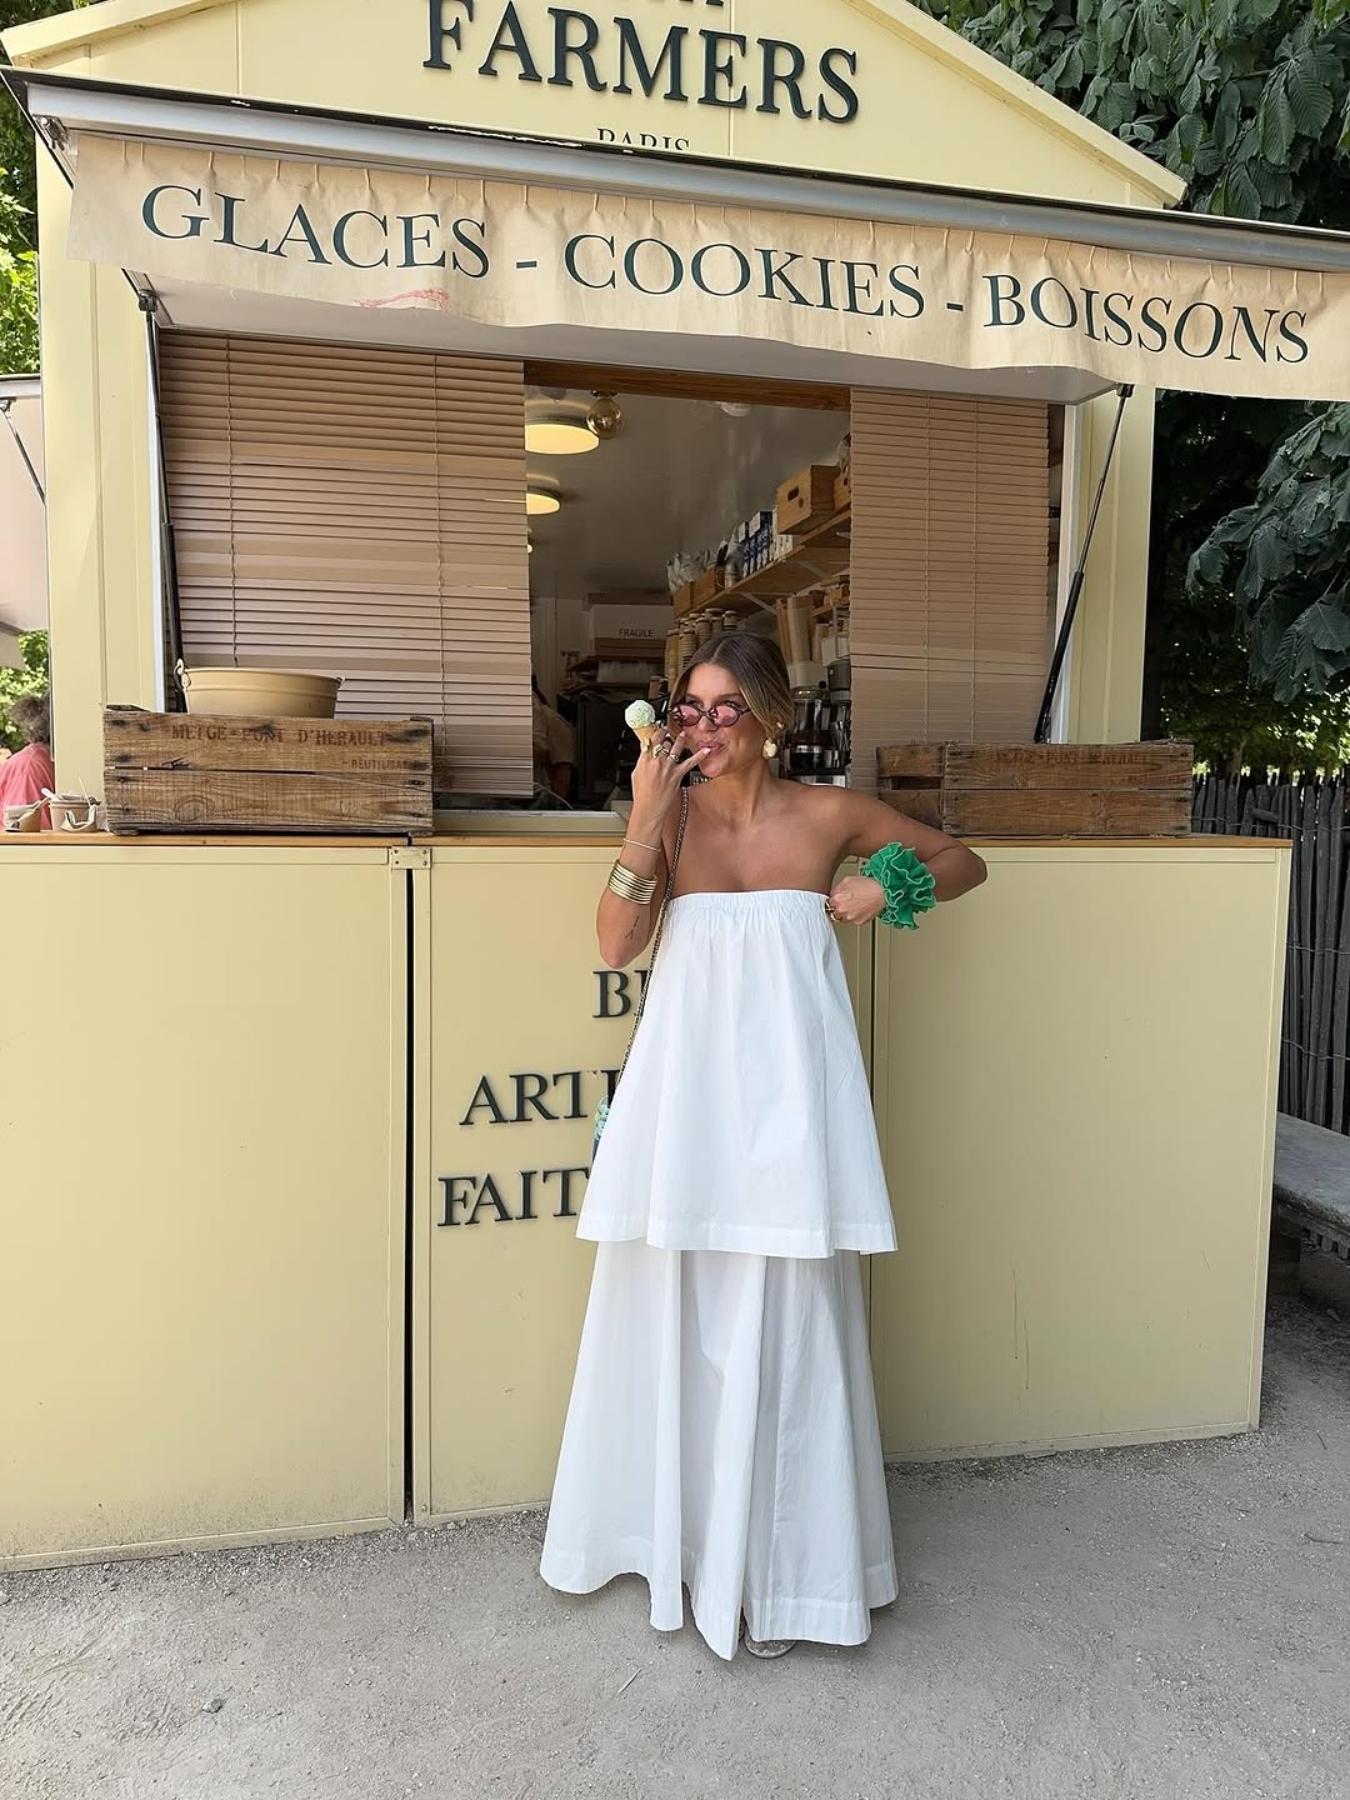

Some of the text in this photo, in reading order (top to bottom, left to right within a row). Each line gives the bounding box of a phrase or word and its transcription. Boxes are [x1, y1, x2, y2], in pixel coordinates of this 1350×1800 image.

[422, 0, 860, 125] FARMERS
[142, 184, 1309, 363] GLACES - COOKIES - BOISSONS
[618, 628, 656, 639] FRAGILE
[437, 1166, 591, 1228] FAIT
